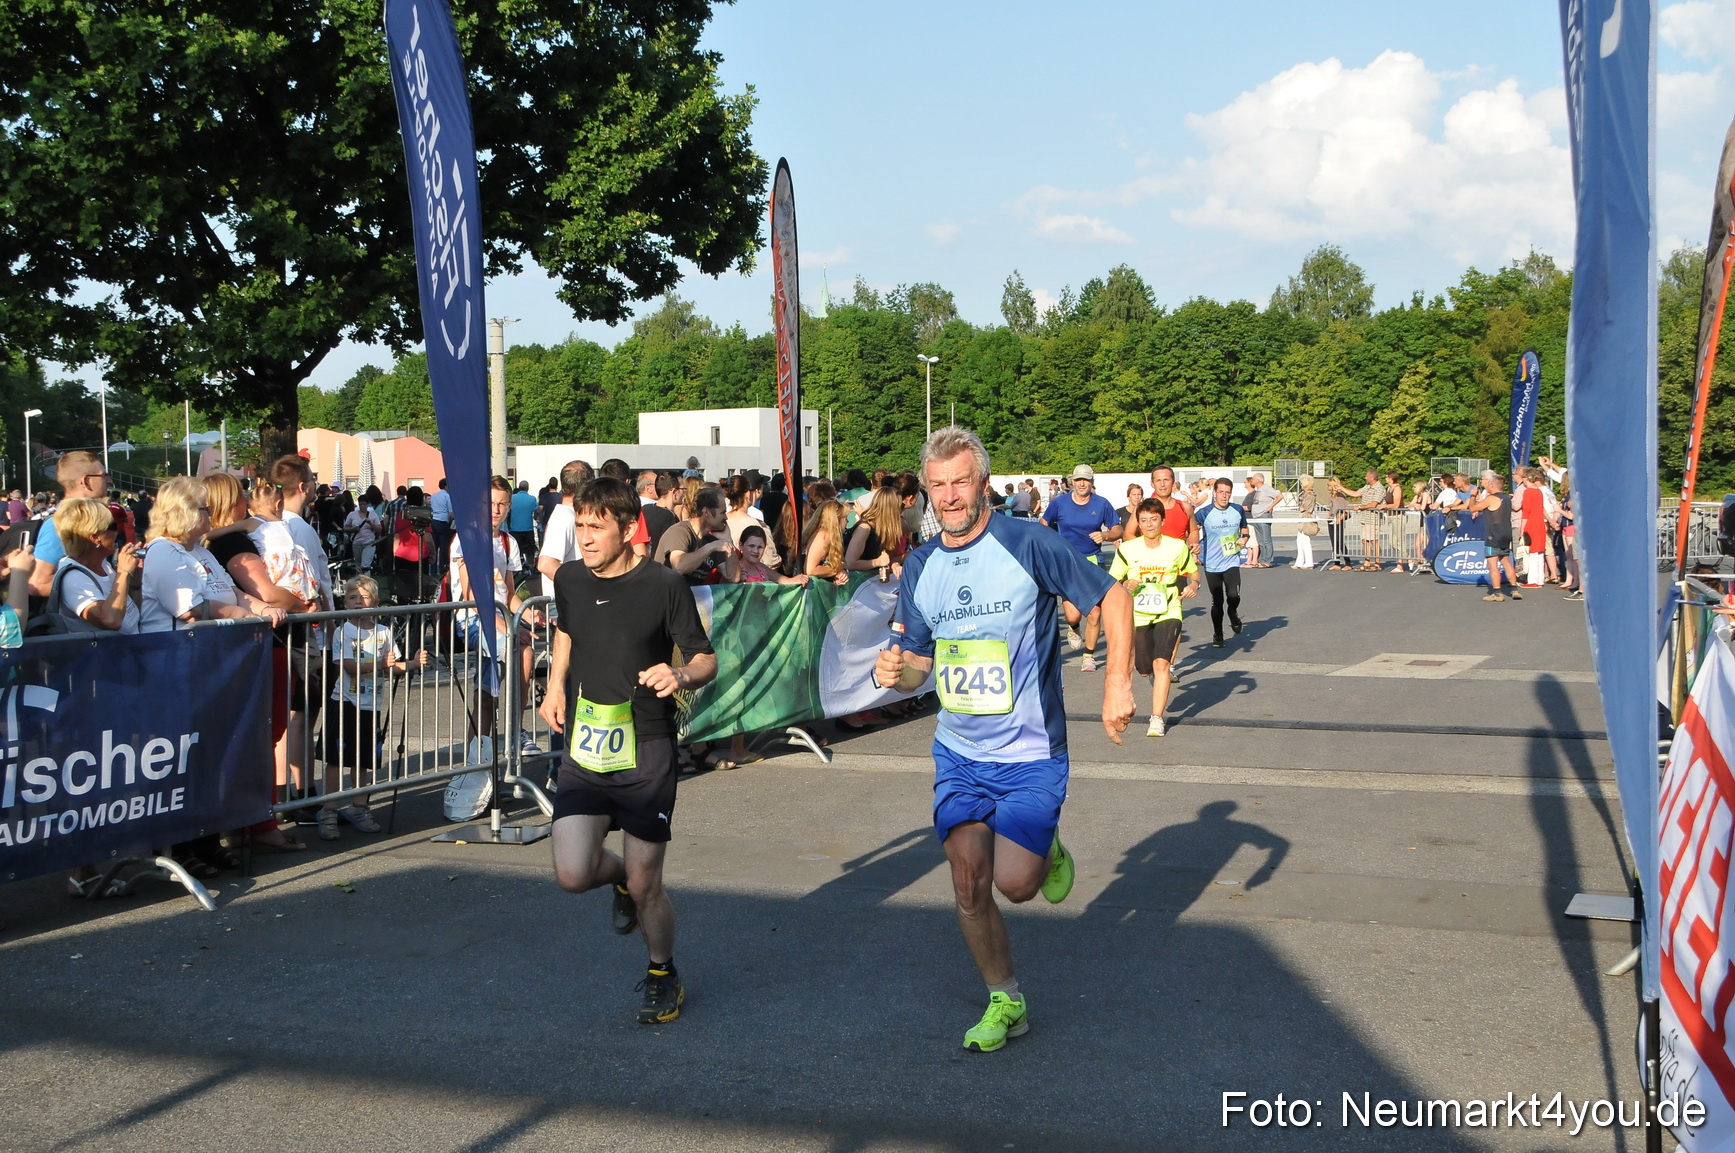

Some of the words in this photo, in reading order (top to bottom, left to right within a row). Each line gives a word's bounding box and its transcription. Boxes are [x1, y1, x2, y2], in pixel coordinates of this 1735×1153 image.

[1137, 593, 1162, 606] 276
[956, 623, 978, 634] TEAM
[939, 666, 1007, 695] 1243
[579, 724, 624, 754] 270
[0, 729, 199, 809] ischer
[0, 787, 185, 847] AUTOMOBILE
